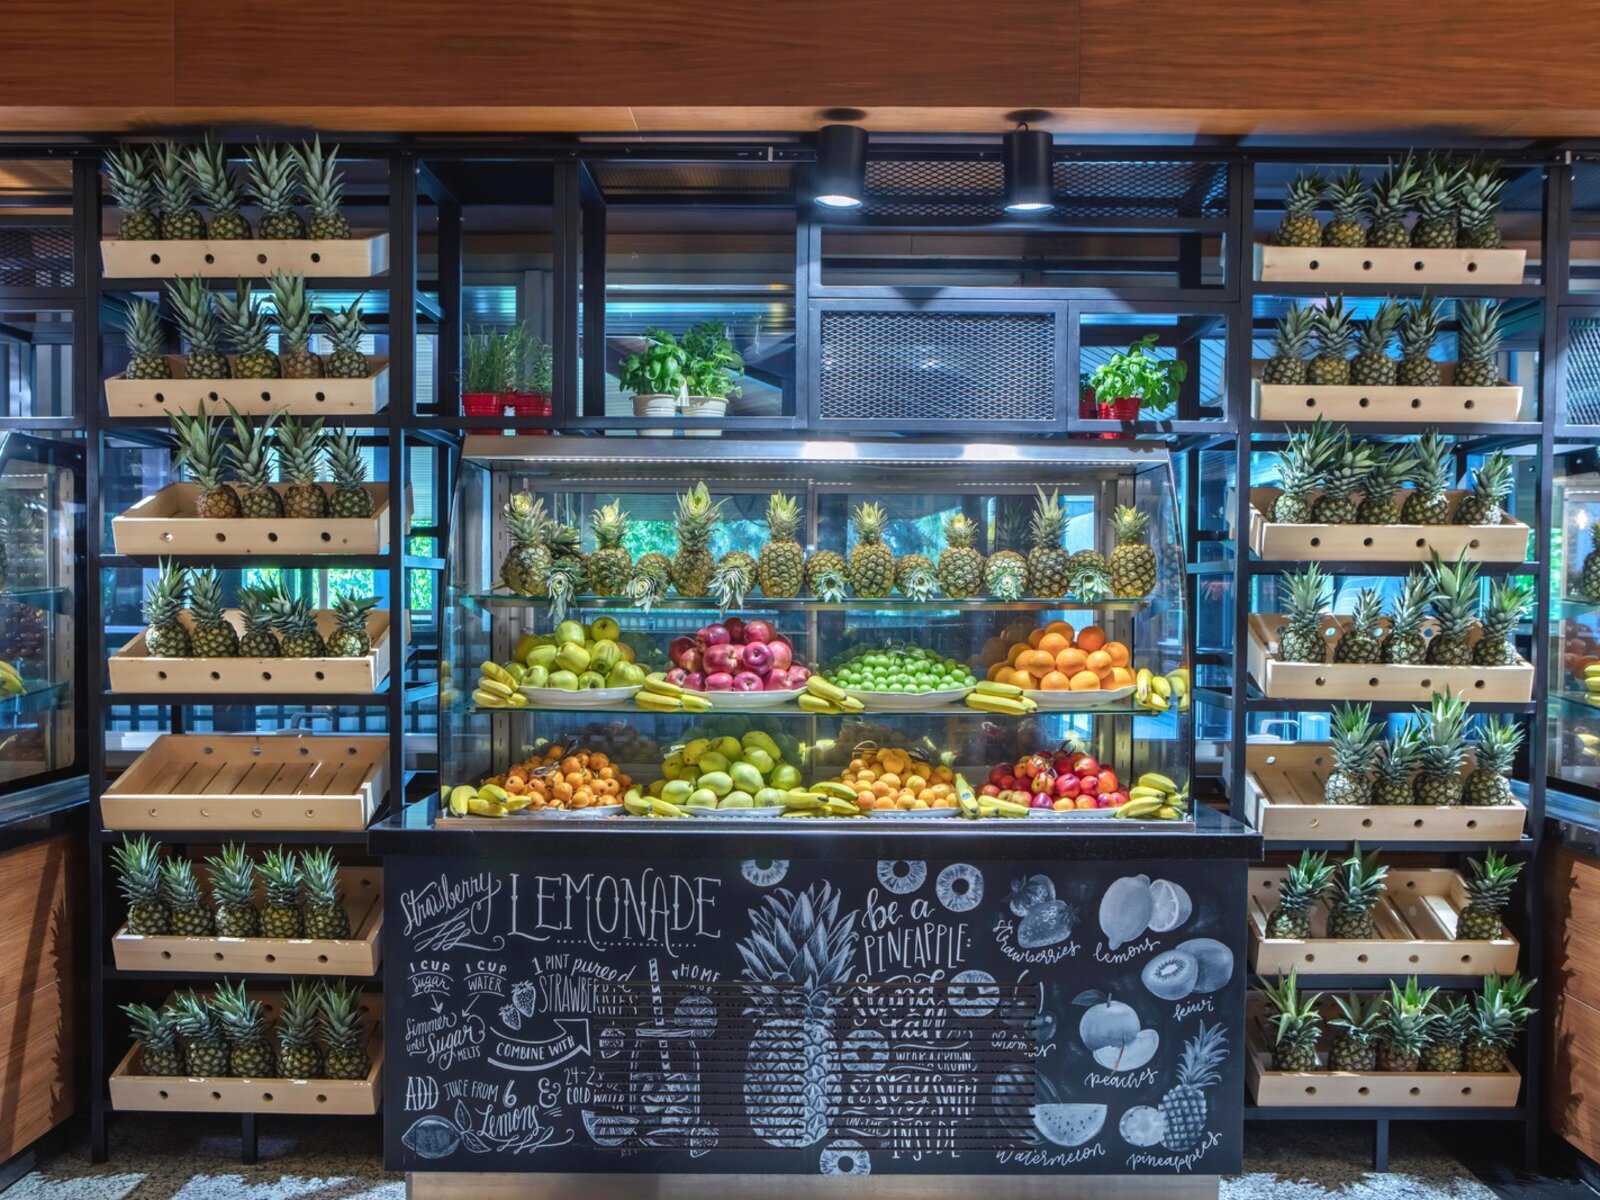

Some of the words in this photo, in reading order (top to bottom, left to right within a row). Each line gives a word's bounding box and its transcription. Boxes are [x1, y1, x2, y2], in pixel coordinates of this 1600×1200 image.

[400, 872, 502, 937] Strawberry
[507, 868, 721, 958] LEMONADE
[861, 888, 903, 931] be
[911, 898, 935, 919] a
[864, 922, 972, 976] PINEAPPLE:
[420, 960, 451, 973] CUP
[477, 960, 507, 974] CUP
[545, 954, 570, 970] PINT
[680, 963, 721, 983] HOME
[468, 975, 502, 992] WATER
[406, 1038, 425, 1052] until
[457, 1046, 481, 1062] MELTS
[496, 1042, 544, 1061] COMBINE
[550, 1038, 576, 1056] WITH
[404, 1076, 440, 1111] ADD
[442, 1080, 469, 1101] JUICE
[471, 1080, 499, 1102] FROM
[503, 1079, 517, 1108] 6
[567, 1087, 591, 1105] COLD
